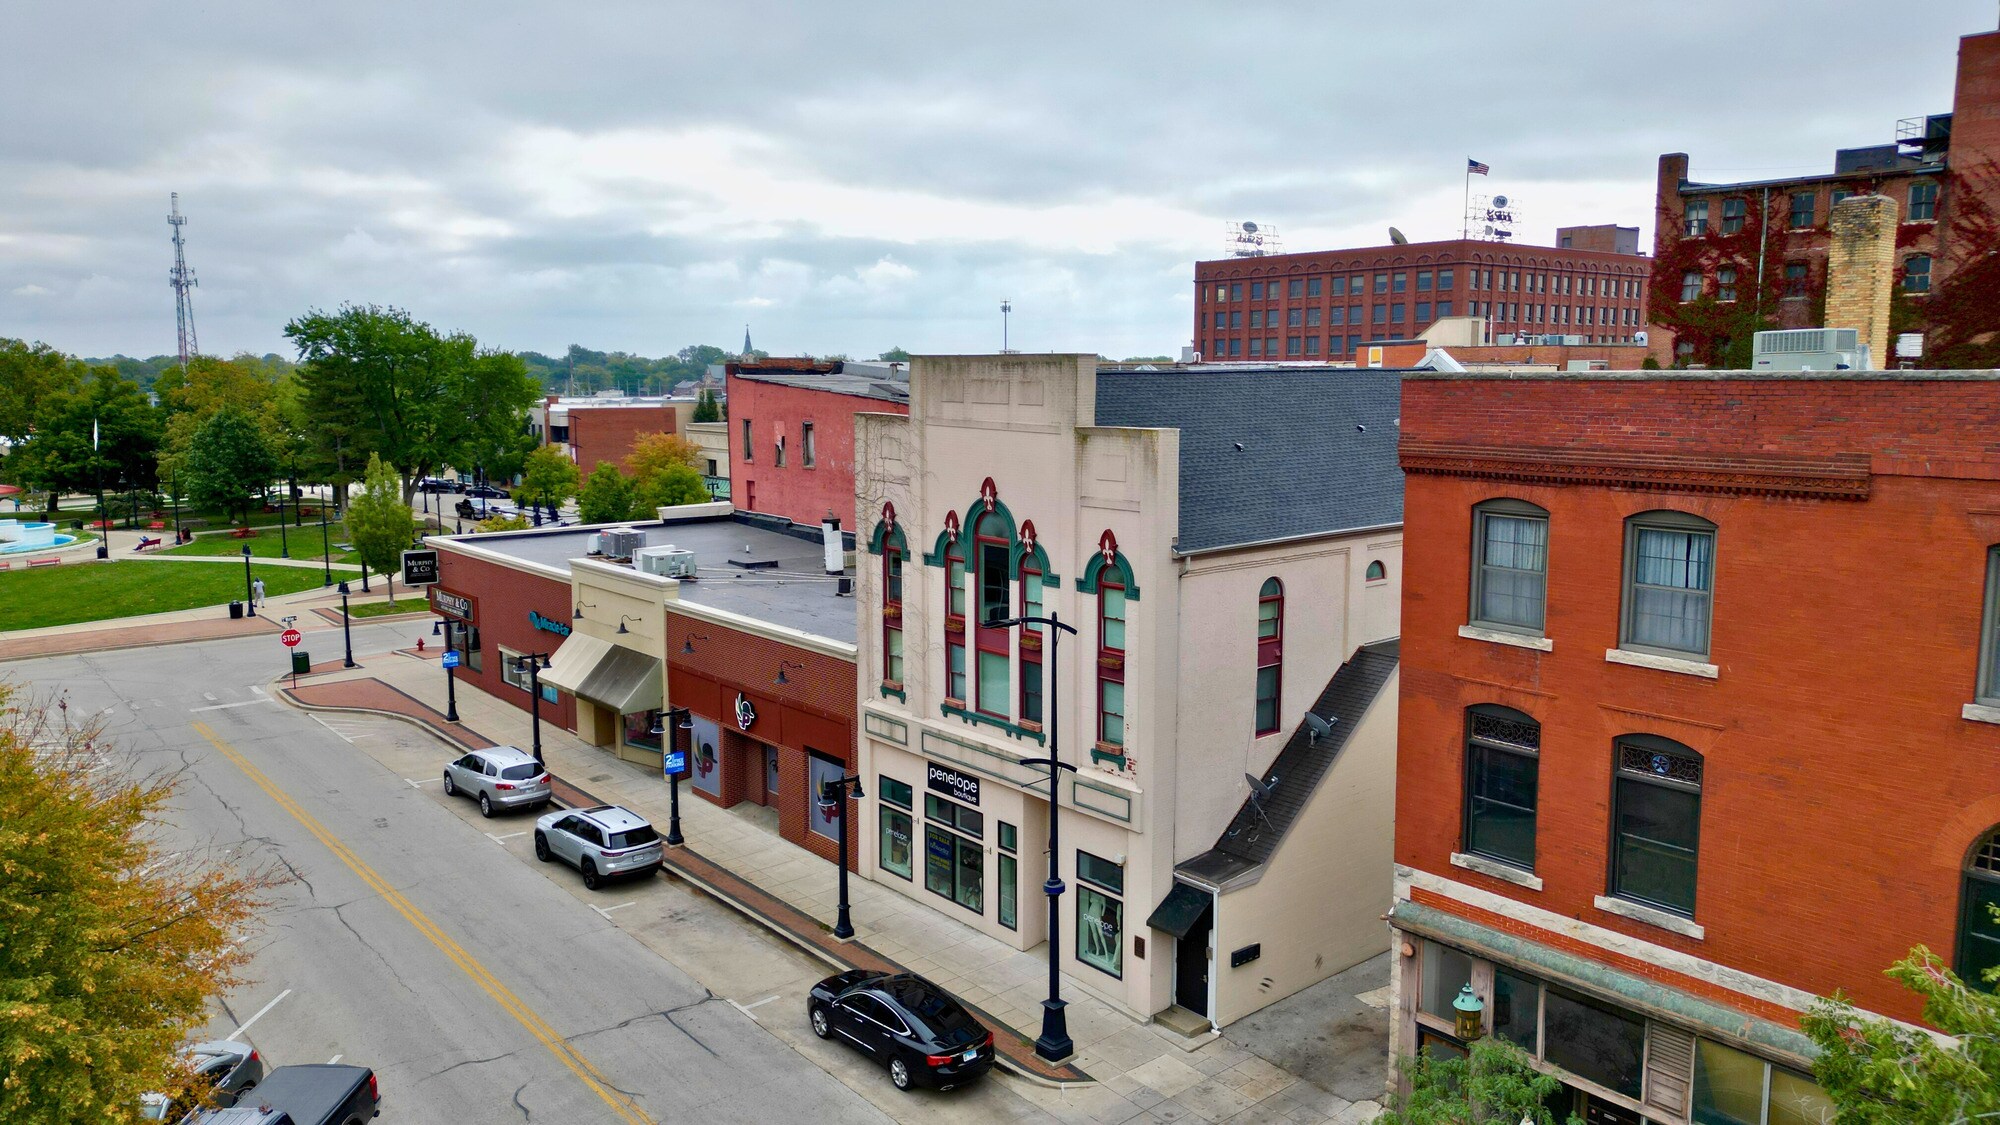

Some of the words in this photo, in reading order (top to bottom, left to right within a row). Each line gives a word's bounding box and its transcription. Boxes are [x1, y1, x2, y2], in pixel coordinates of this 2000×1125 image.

[454, 596, 460, 608] &
[282, 633, 300, 643] STOP
[929, 767, 977, 793] penelope
[953, 787, 977, 803] boutique
